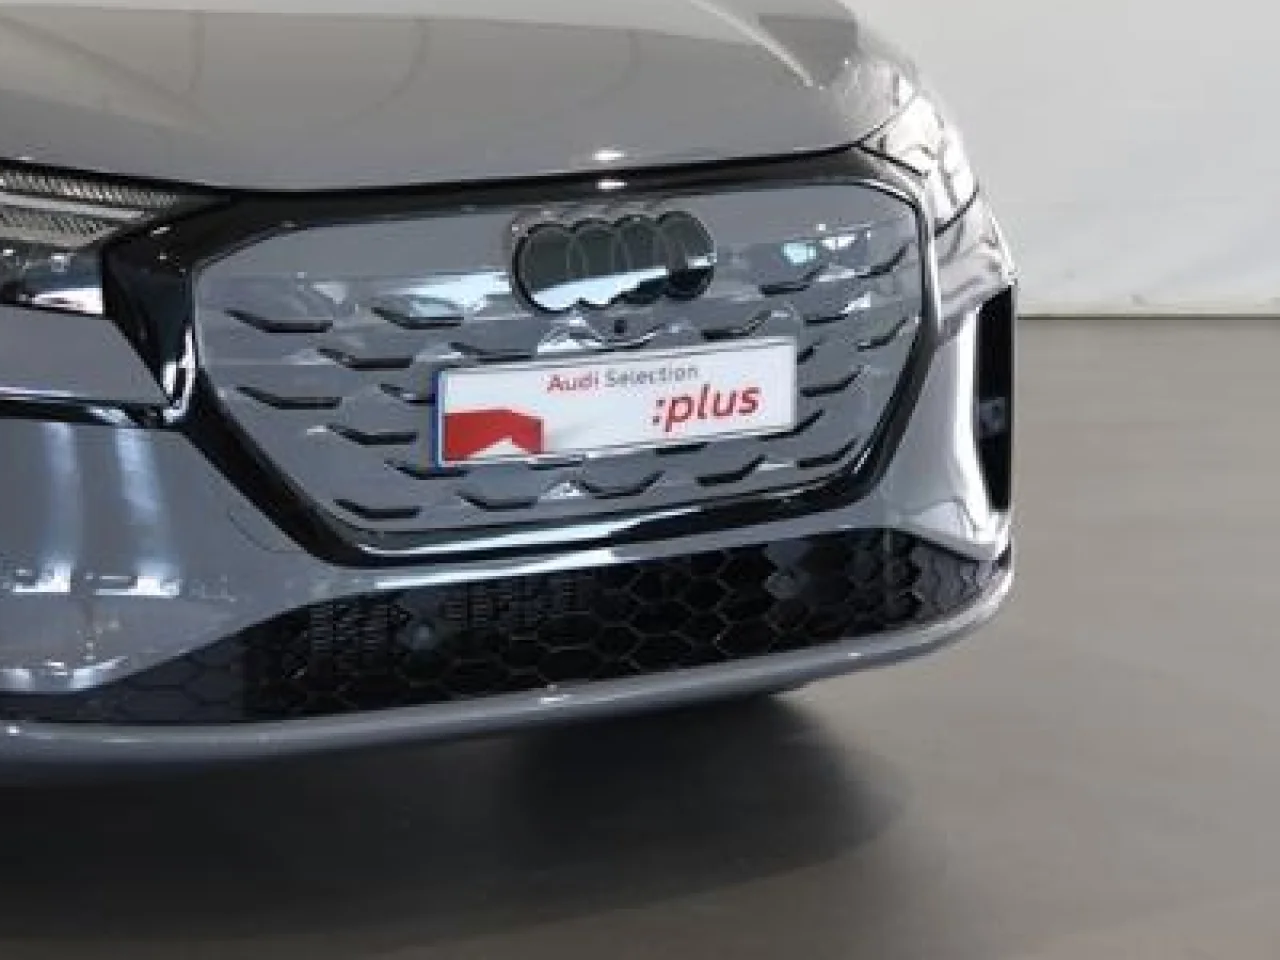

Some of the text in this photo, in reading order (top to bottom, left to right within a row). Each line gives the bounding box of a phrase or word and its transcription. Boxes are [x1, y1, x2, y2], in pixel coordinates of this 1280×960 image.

[547, 363, 700, 392] Audi Selection
[653, 383, 761, 433] :plus
